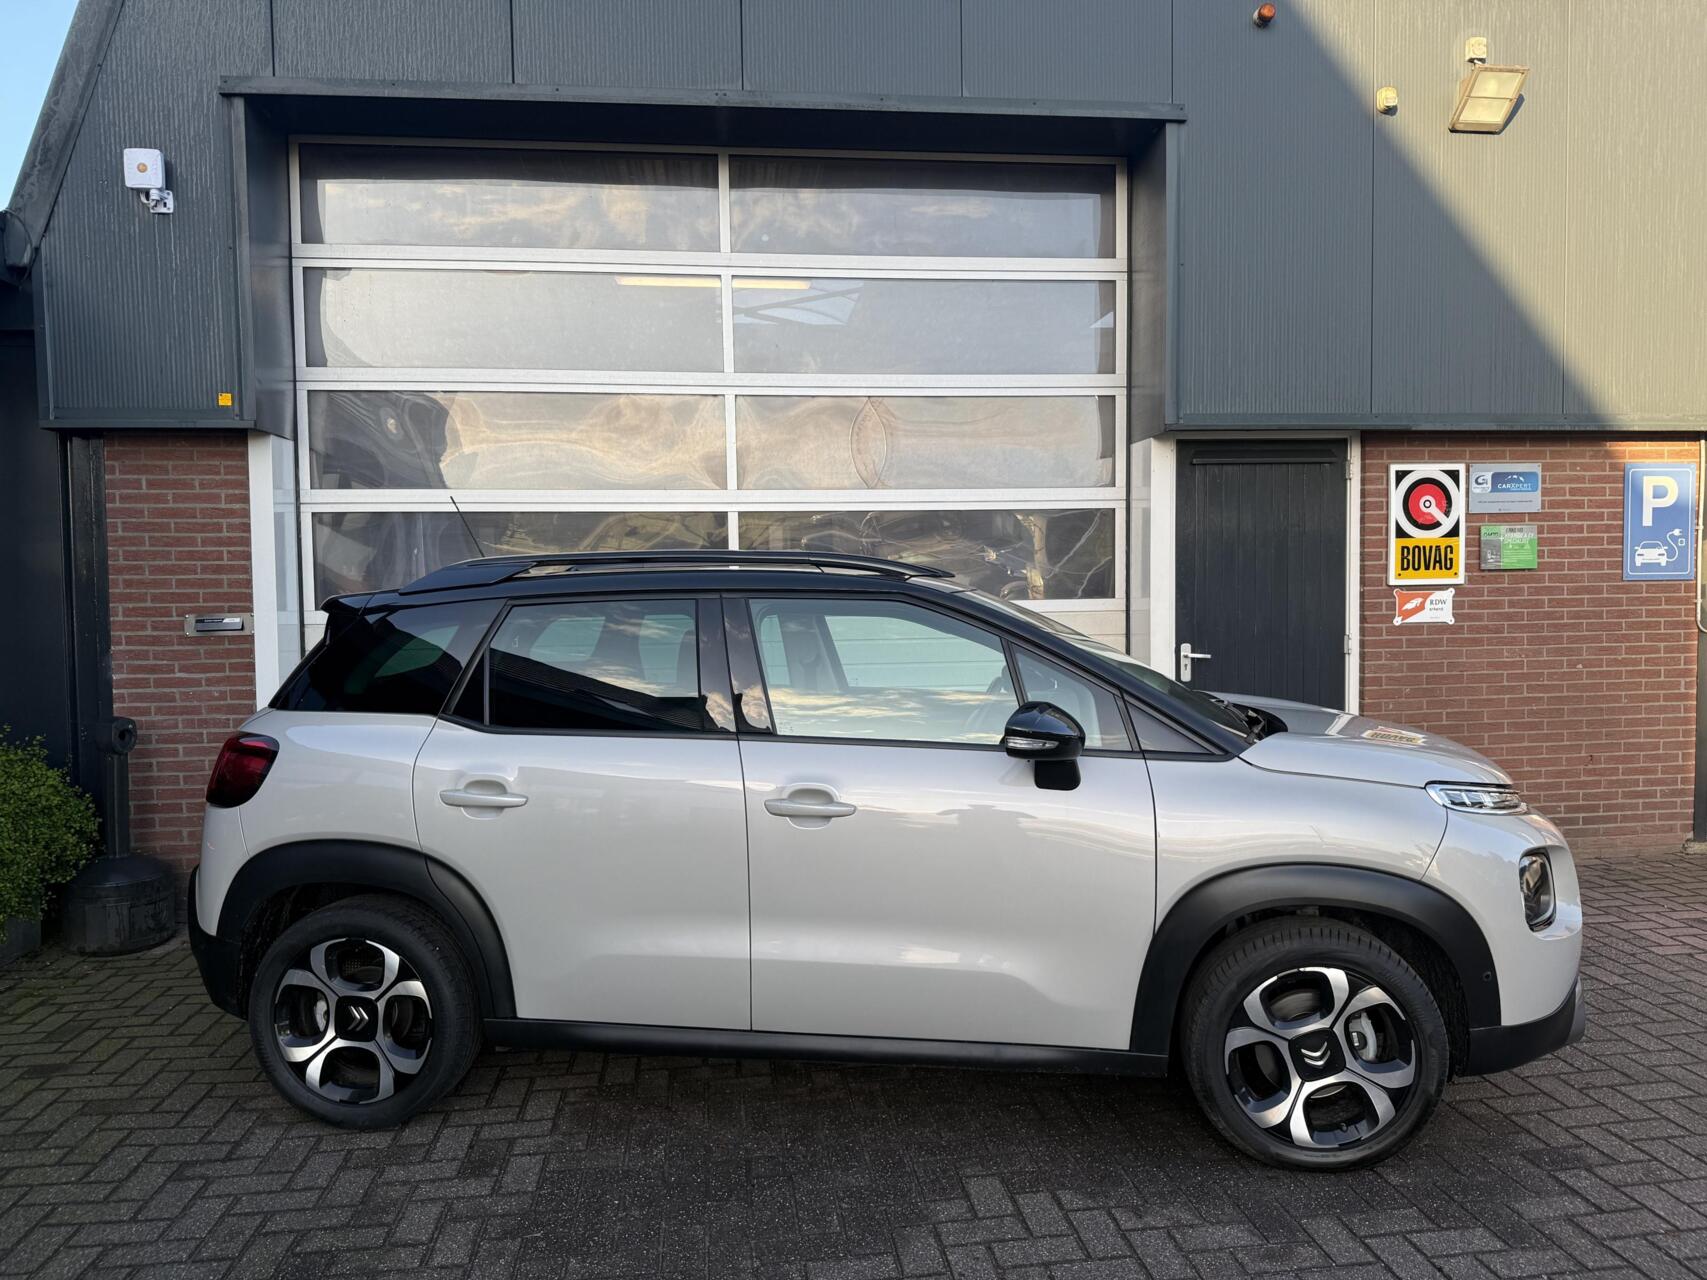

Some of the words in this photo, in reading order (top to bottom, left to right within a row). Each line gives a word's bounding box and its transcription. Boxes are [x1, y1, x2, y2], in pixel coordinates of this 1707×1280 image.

[1642, 475, 1679, 526] P
[1400, 545, 1454, 571] BOVAG
[1429, 598, 1447, 606] RDW
